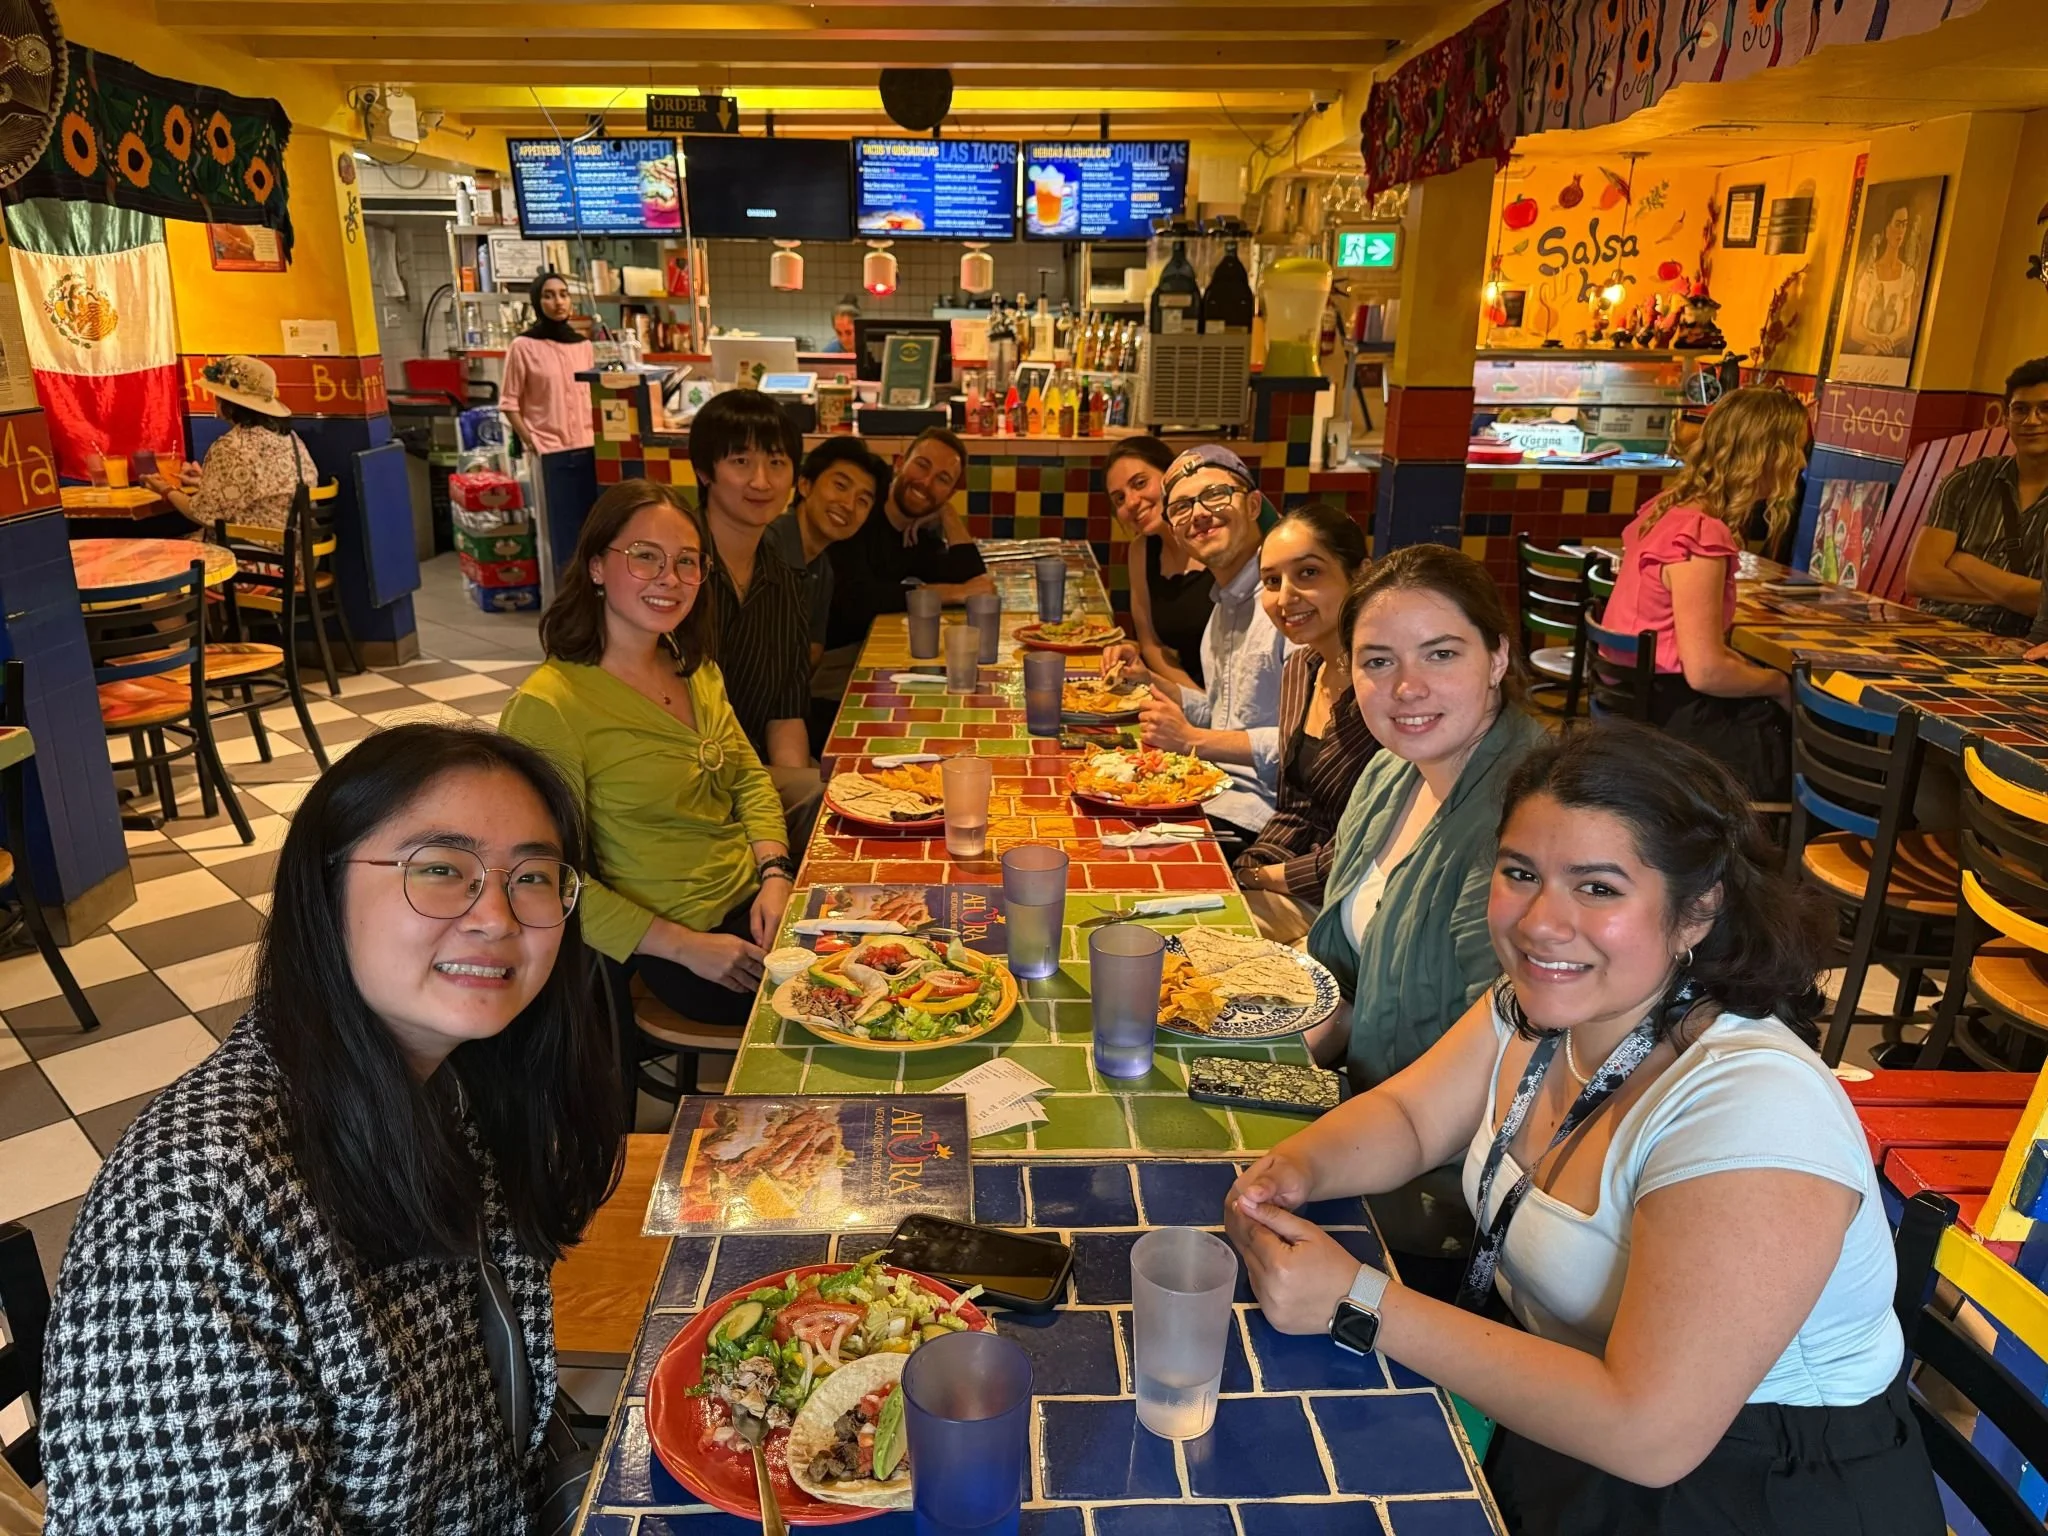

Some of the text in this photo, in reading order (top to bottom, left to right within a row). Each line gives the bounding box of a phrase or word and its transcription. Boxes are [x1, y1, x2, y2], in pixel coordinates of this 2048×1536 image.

[652, 97, 708, 112] ORDER
[652, 114, 696, 129] HERE
[1537, 217, 1640, 277] Salsa
[1828, 389, 1905, 442] Tacos
[1636, 1039, 1653, 1058] RSC
[1583, 1033, 1646, 1101] Mechanochemistry
[874, 1106, 886, 1134] MEXICAN
[873, 1133, 884, 1159] CUISINE
